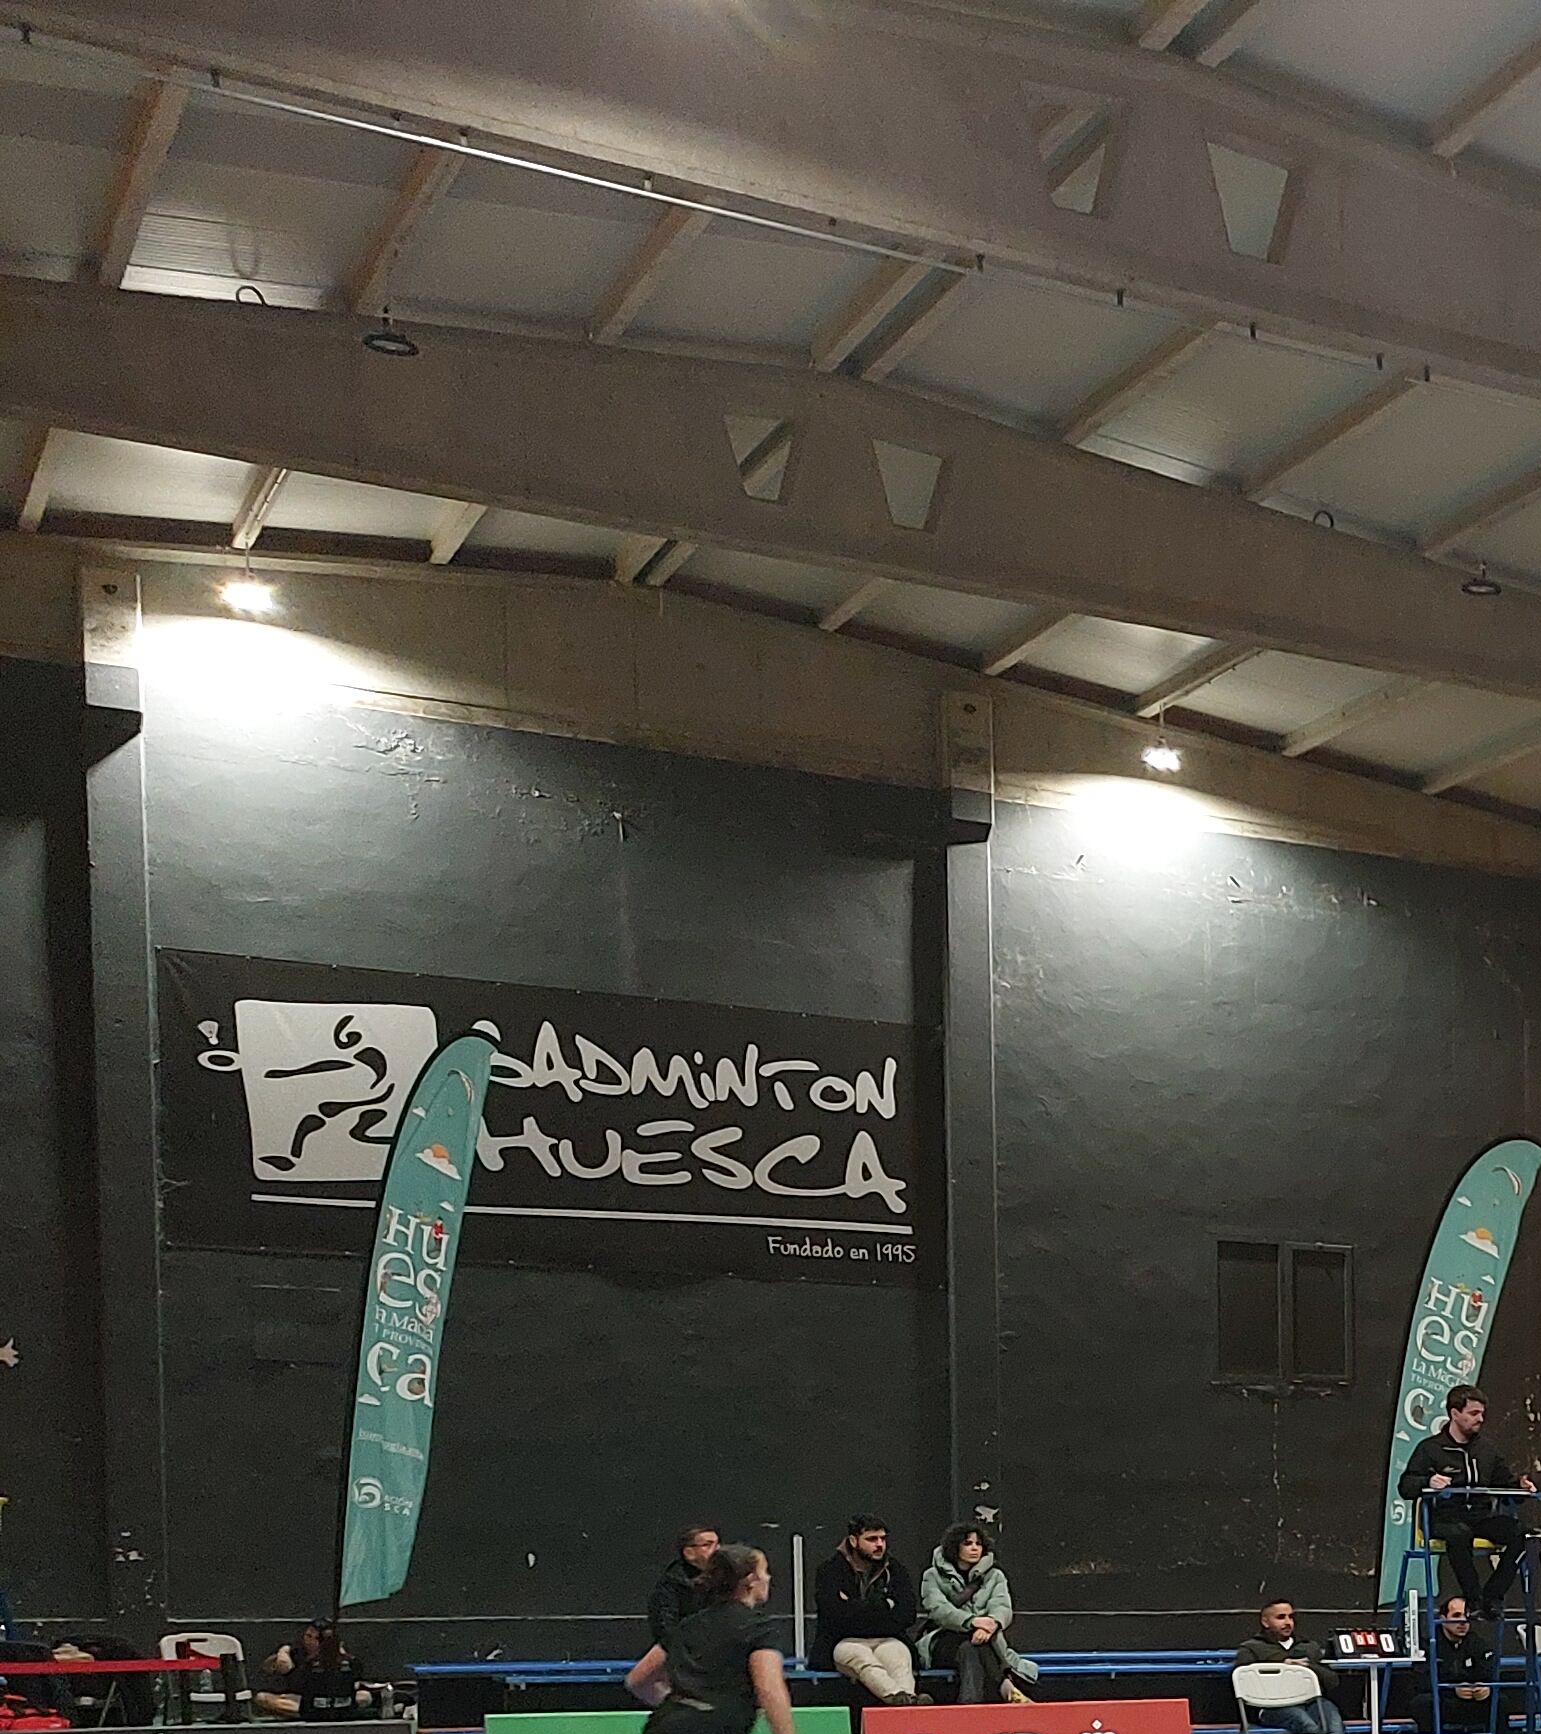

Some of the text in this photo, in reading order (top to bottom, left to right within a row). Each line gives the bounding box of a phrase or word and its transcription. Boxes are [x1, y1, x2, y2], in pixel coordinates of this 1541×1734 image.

[476, 1116, 907, 1213] HUESCA
[767, 1236, 916, 1263] Fundado en 1995
